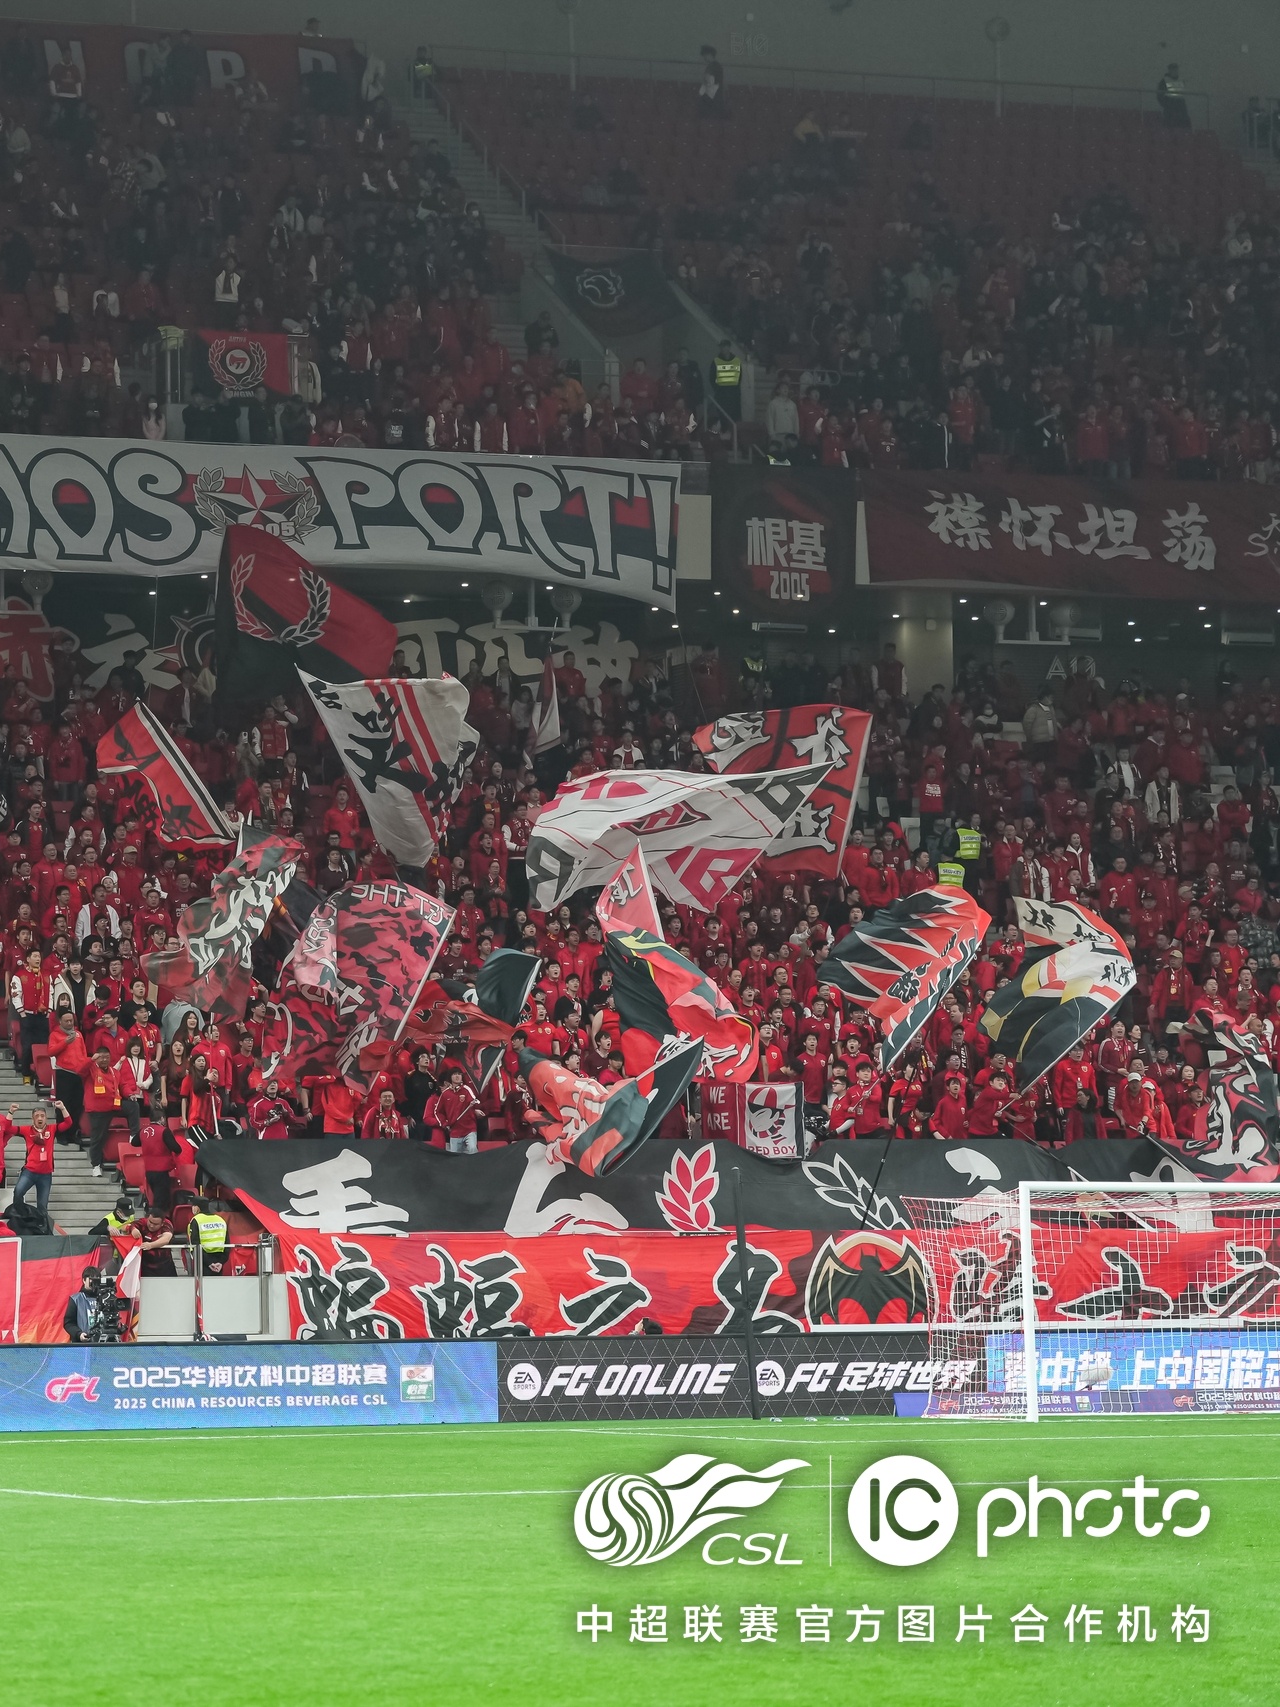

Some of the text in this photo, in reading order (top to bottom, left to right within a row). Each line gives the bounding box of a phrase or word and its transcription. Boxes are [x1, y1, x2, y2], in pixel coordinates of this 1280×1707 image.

[293, 455, 677, 597] PORT!
[746, 517, 827, 572] 根基
[769, 570, 810, 601] 2005
[708, 1086, 726, 1105] WE
[706, 1112, 731, 1132] ARE
[773, 1145, 797, 1157] BOY
[112, 1364, 389, 1390] 2025华润饮料中超联赛
[513, 1371, 535, 1384] EA
[541, 1363, 738, 1397] FC ONLINE
[758, 1379, 781, 1387] SPORTS
[759, 1368, 780, 1380] EA
[785, 1360, 977, 1394] FC 足球世界
[512, 1383, 537, 1391] SPORTS
[113, 1395, 389, 1410] 2025 CHINA RESOURCES BEVERAGE CSL
